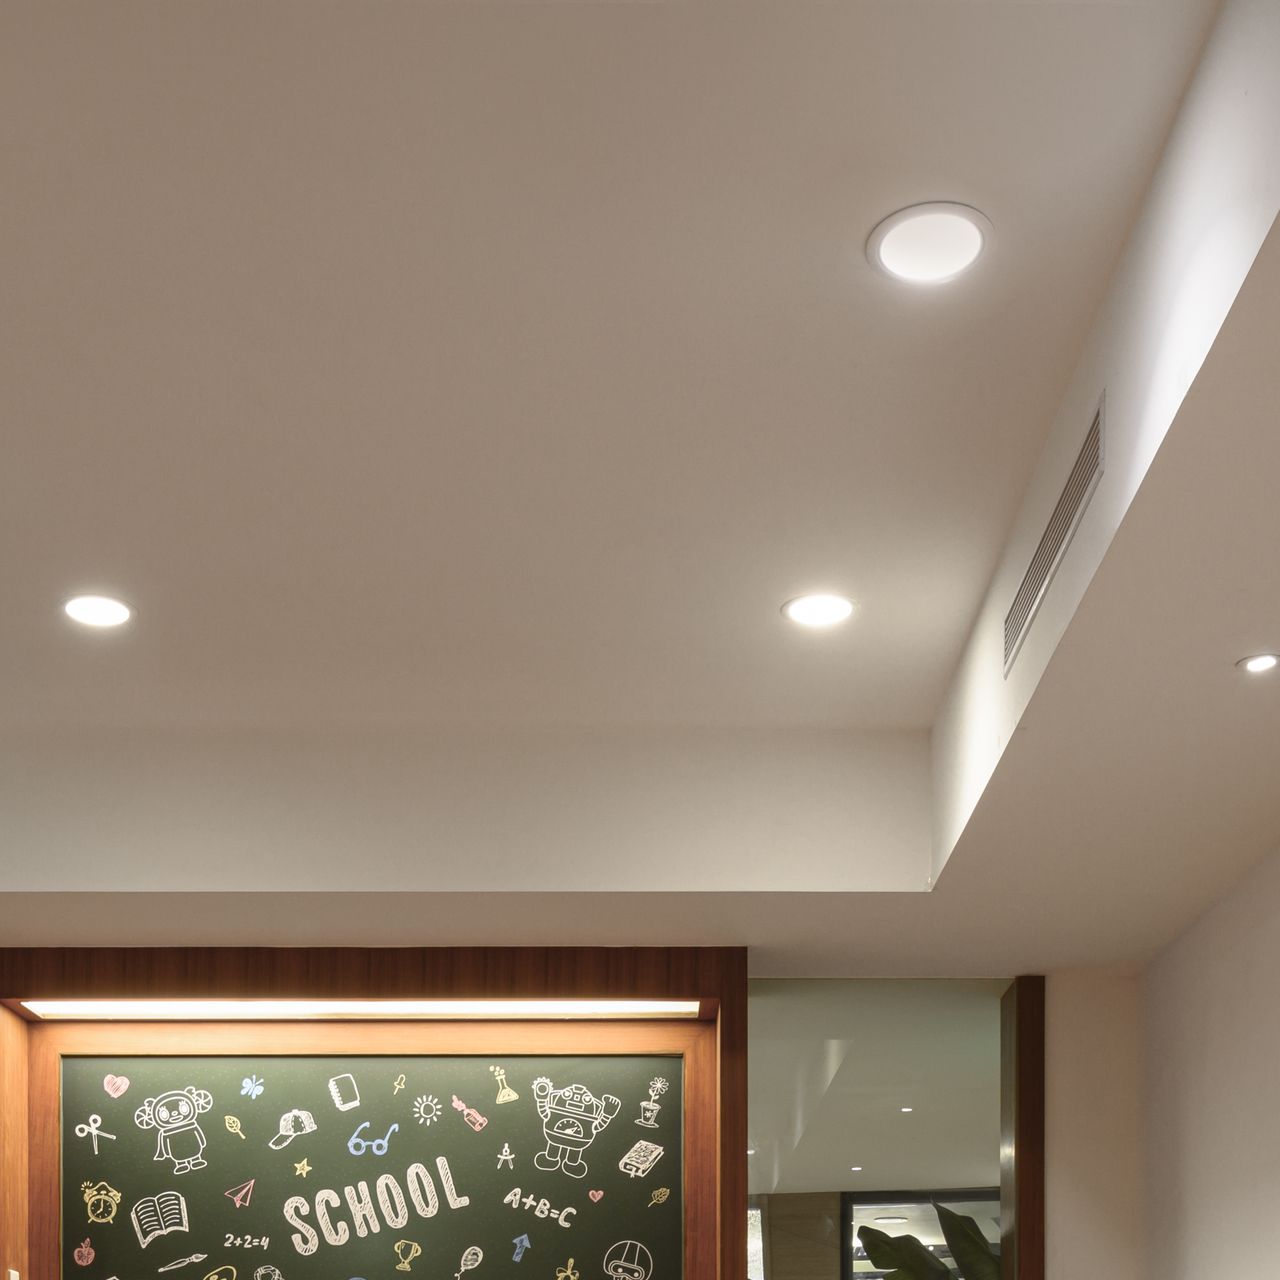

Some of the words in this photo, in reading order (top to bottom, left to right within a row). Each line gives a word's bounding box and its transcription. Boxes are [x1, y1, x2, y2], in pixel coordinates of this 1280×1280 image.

[283, 1155, 470, 1256] SCHOOL
[503, 1187, 578, 1228] A+B=C
[223, 1233, 270, 1250] 2+2=4
